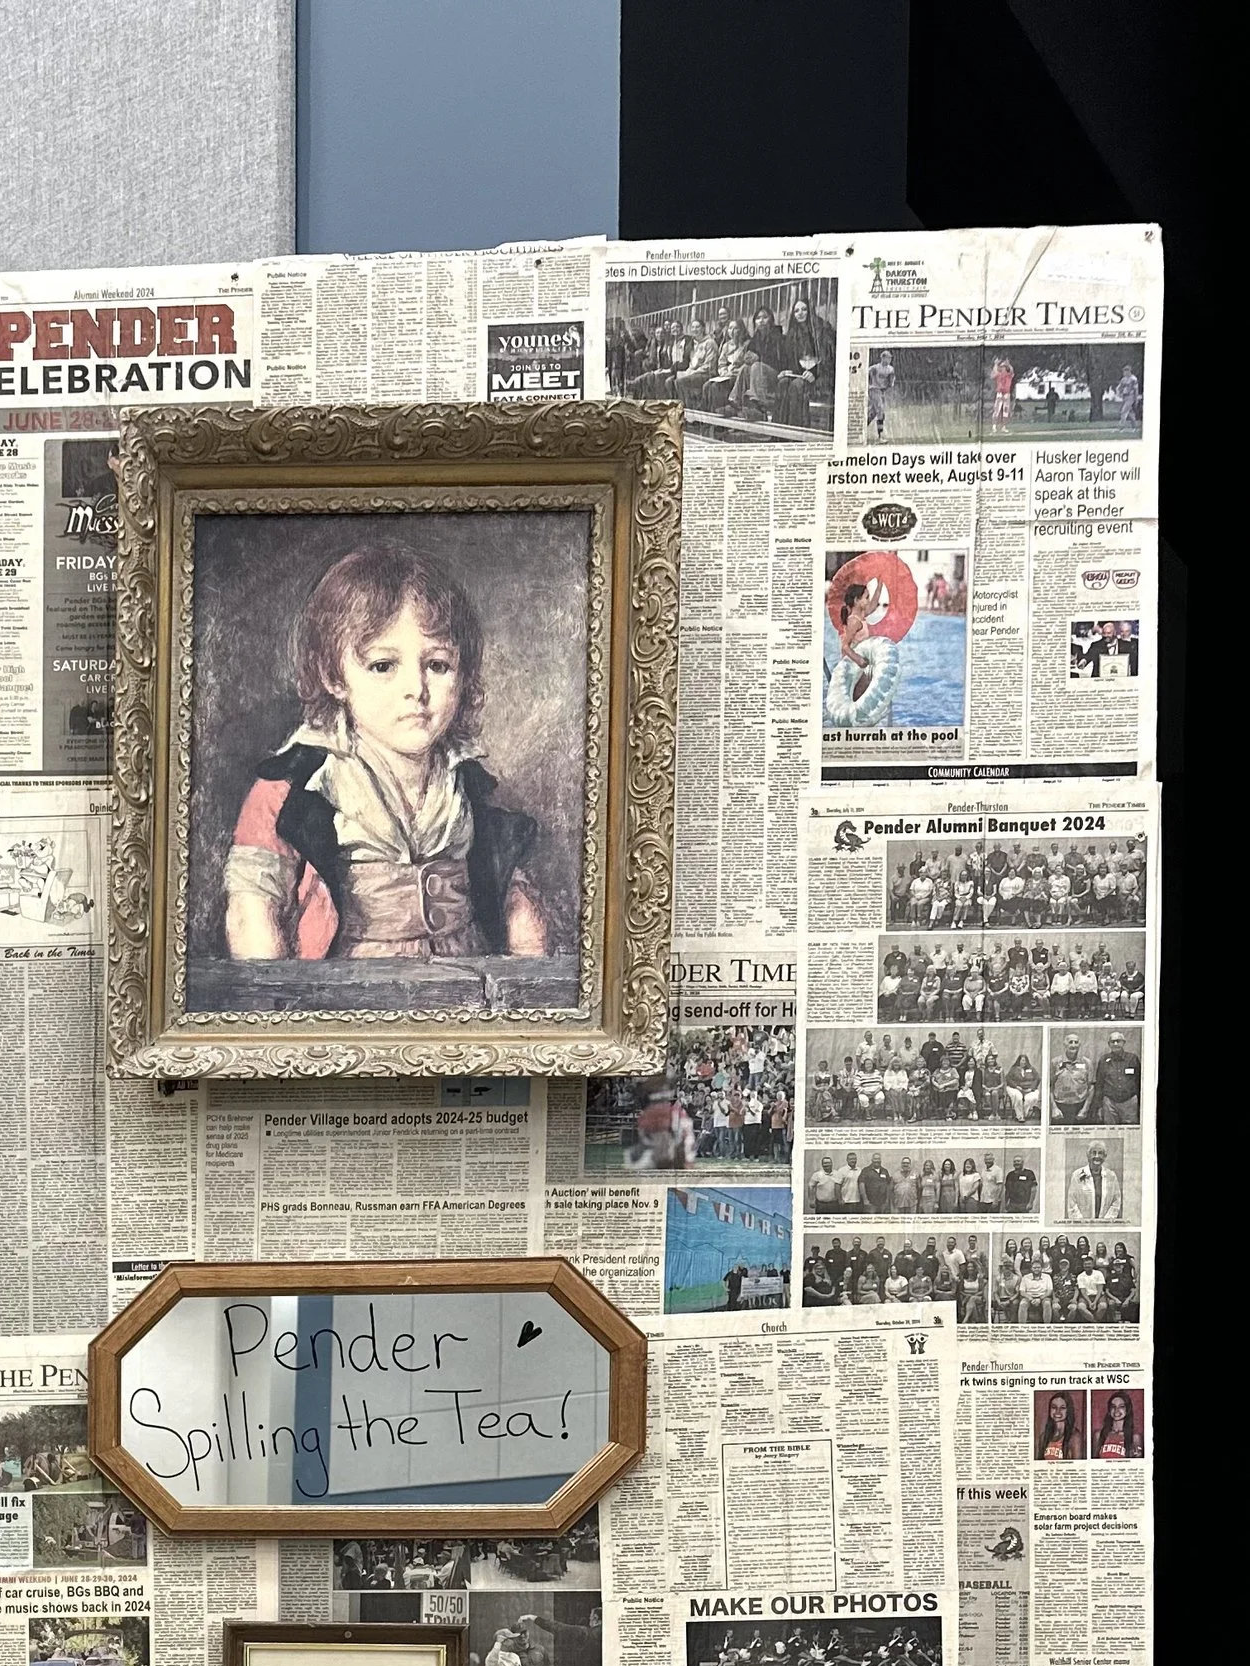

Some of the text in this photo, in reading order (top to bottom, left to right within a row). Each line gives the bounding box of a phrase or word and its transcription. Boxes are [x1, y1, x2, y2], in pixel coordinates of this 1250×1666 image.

[851, 302, 1124, 329] THE PENDER TIMES
[492, 370, 581, 391] MEET
[927, 766, 1010, 780] COMMUNITY CALENDAR
[864, 816, 1106, 836] Pender Alumni Banquet 2024
[264, 1109, 529, 1129] Pender Village board adopts 2024-25 budget
[224, 1302, 466, 1378] Pender
[130, 1388, 571, 1498] Spilling the Tea!
[5, 1589, 23, 1599] car
[25, 1587, 64, 1599] cruise,
[66, 1585, 91, 1598] BGs
[94, 1585, 120, 1597] BBQ
[122, 1585, 144, 1597] and
[5, 1604, 39, 1614] music
[41, 1602, 79, 1614] shows
[81, 1601, 109, 1613] back
[111, 1601, 122, 1613] in
[124, 1600, 151, 1612] 2024
[690, 1593, 938, 1617] MAKE OUR PHOTOS
